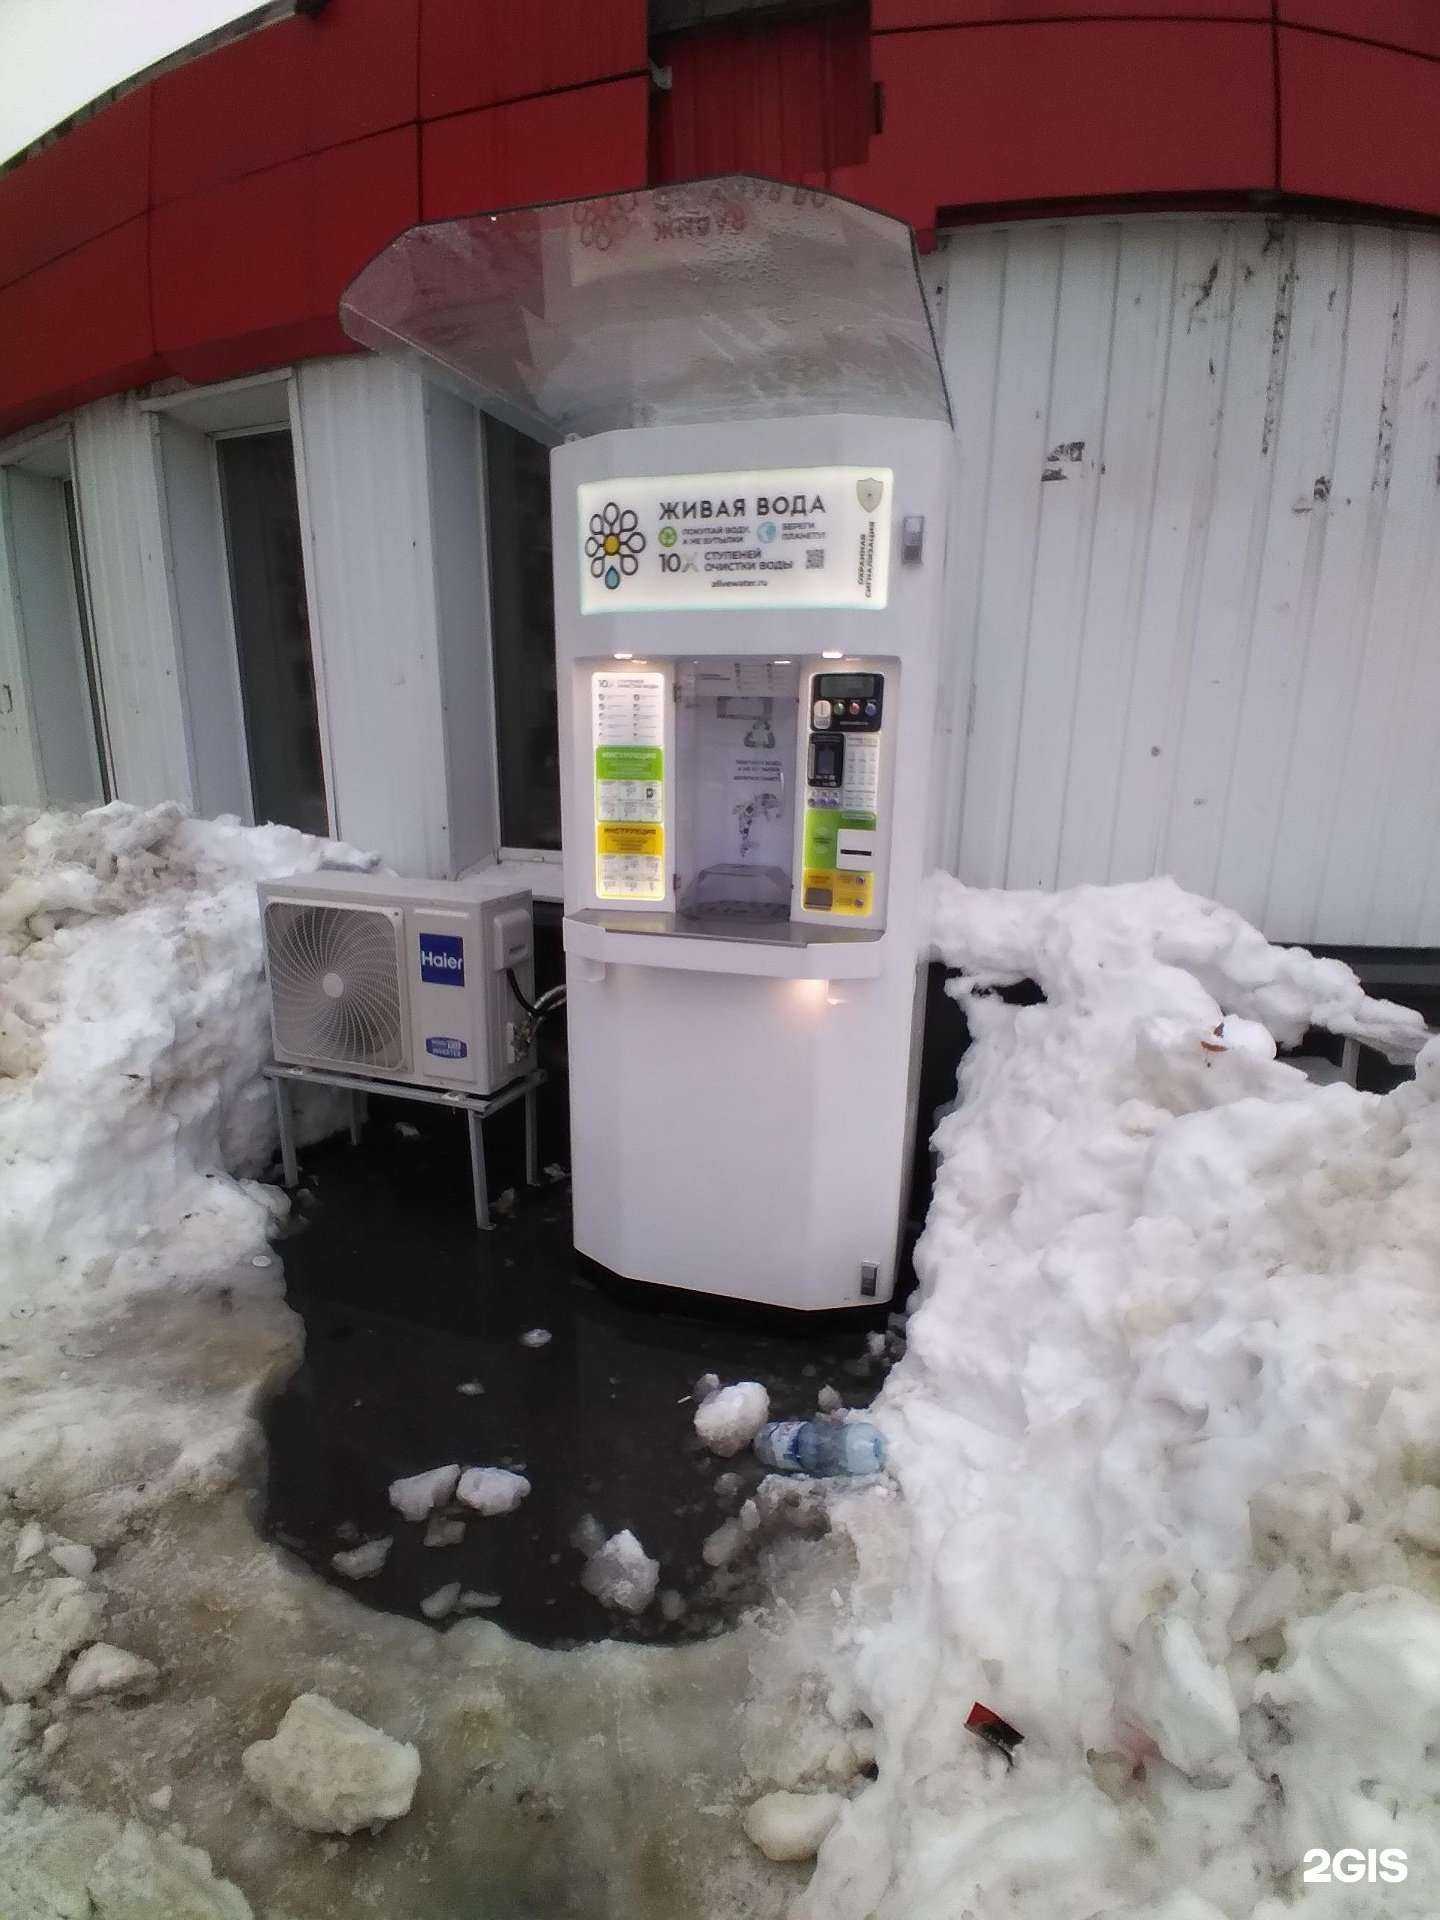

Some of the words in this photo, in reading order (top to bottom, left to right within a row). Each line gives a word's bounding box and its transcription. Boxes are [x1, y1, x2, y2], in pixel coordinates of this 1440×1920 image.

[659, 498, 745, 520] ЖИВАЯ
[757, 494, 826, 516] ВОДА
[704, 548, 761, 560] СТУПЕНЕЙ
[704, 561, 756, 571] ОЧИСТКИ
[760, 560, 793, 570] ВОДЫ
[421, 951, 463, 970] Haier
